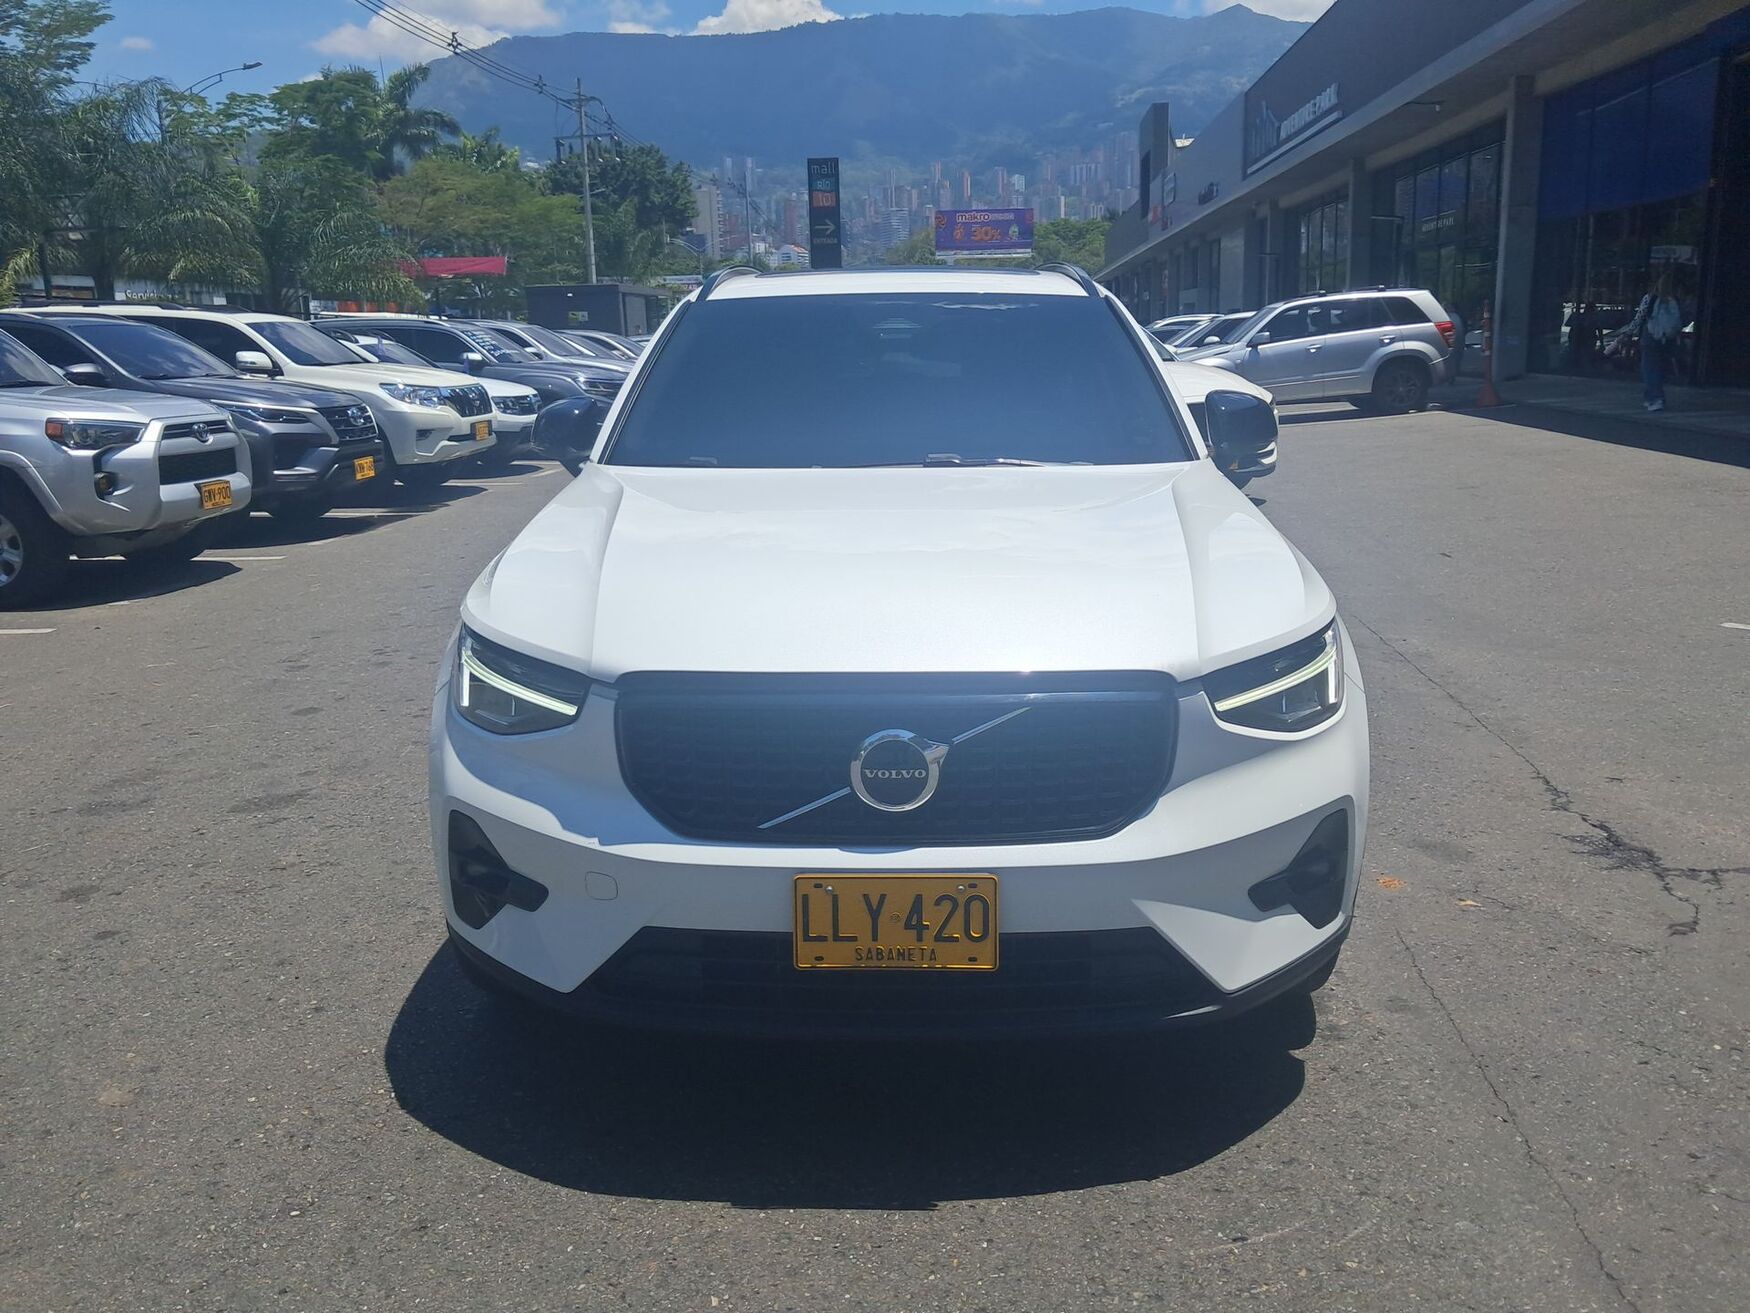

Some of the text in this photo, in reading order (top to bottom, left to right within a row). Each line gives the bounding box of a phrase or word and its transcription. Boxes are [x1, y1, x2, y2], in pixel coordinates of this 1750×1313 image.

[811, 162, 835, 175] mall
[956, 212, 991, 223] makro
[863, 769, 927, 779] VOLVO
[854, 945, 938, 962] SABANETA
